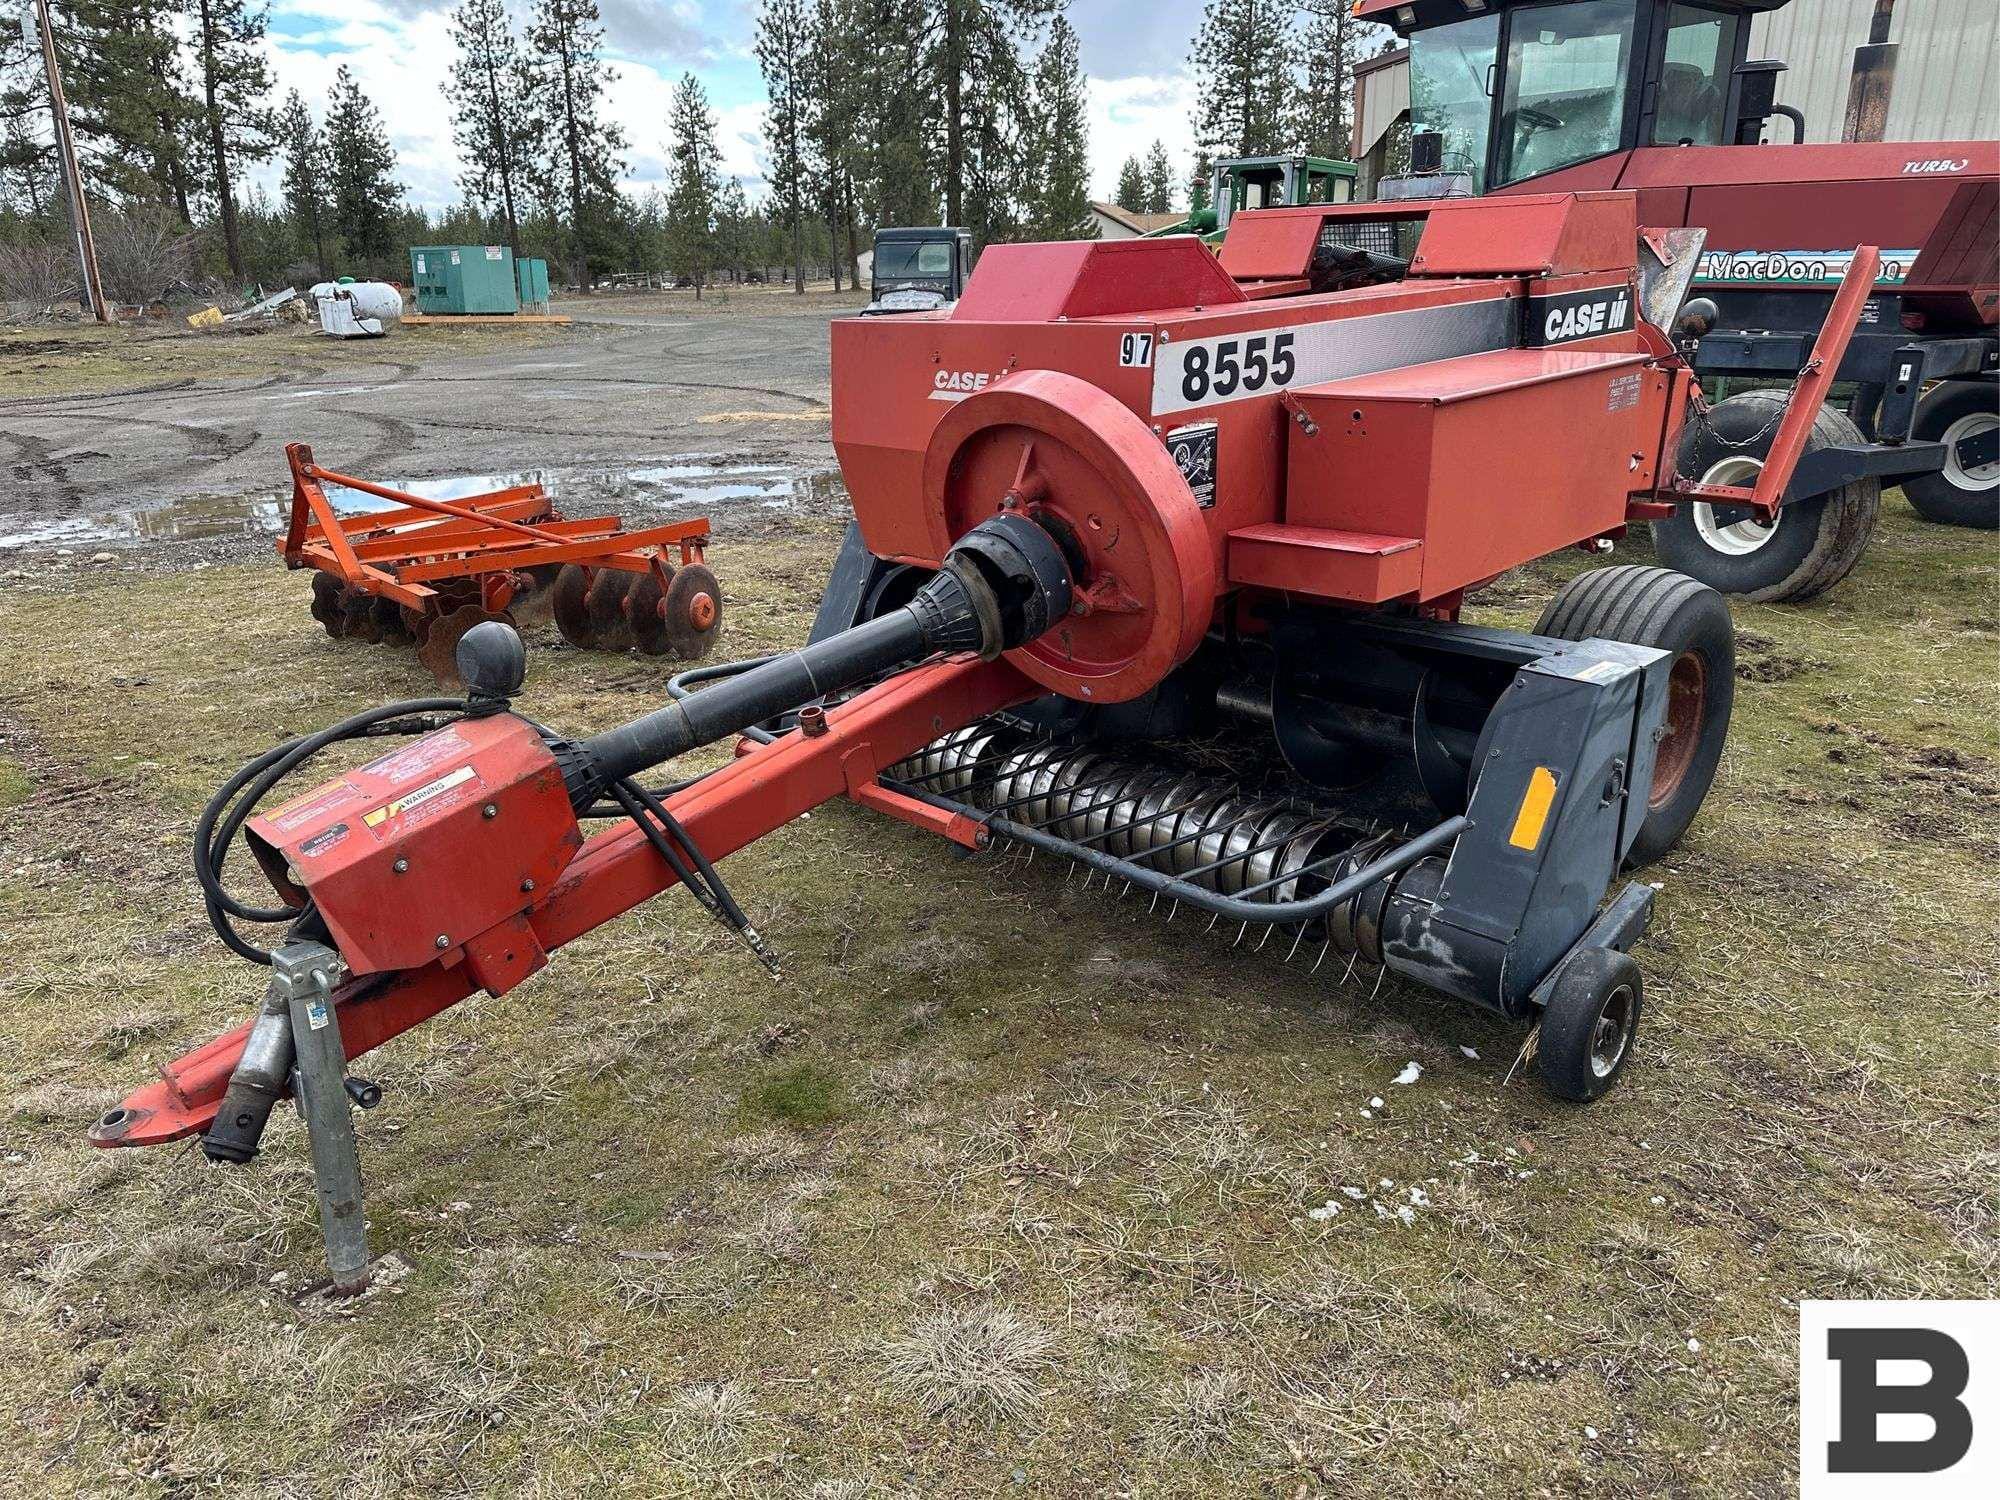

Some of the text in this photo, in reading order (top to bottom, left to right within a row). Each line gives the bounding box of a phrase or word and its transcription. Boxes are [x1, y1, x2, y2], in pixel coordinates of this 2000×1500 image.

[1902, 159, 1968, 174] TURBO
[1706, 253, 1826, 281] MacDon
[1545, 302, 1607, 341] CASE
[1122, 335, 1152, 365] 97
[934, 369, 989, 391] CASE
[1182, 333, 1296, 402] 8555
[403, 782, 446, 806] WARNING
